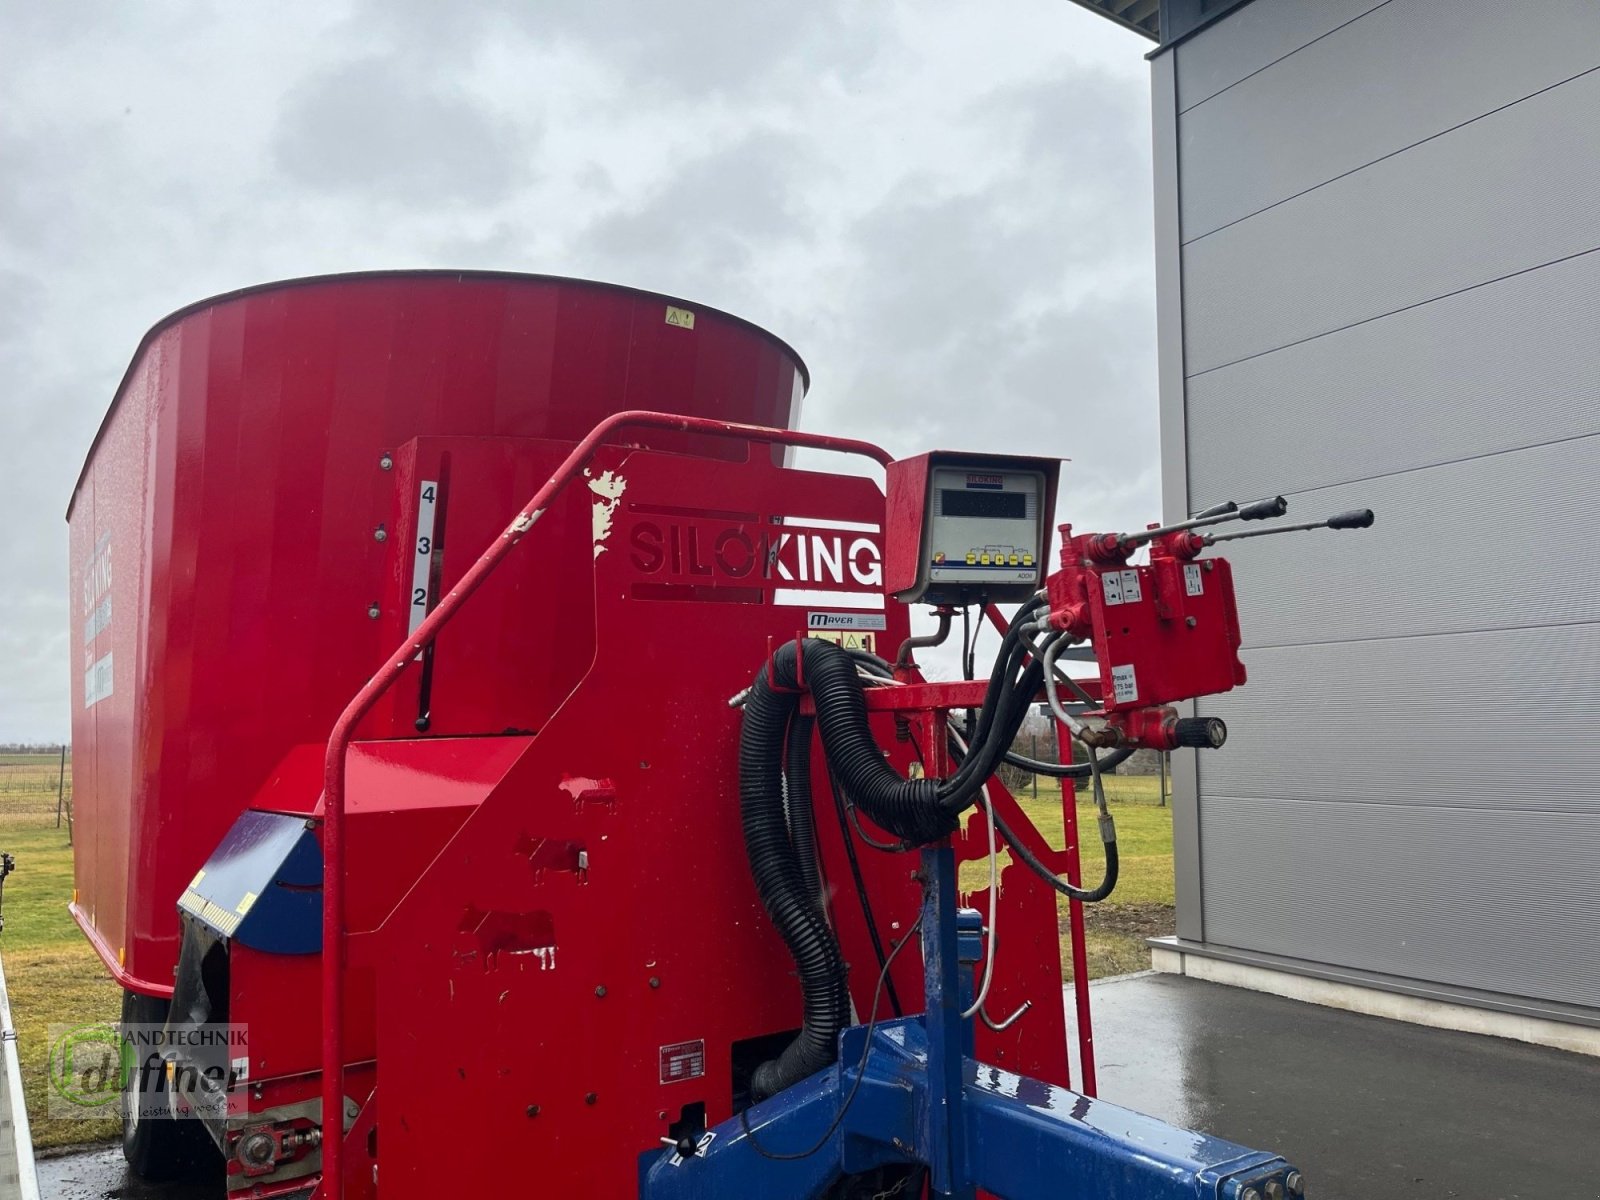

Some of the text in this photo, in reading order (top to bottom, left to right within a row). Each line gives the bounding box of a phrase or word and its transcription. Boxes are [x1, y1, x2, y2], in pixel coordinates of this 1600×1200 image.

[422, 486, 435, 504] 4
[418, 537, 430, 554] 3
[630, 521, 882, 586] SILOKING
[413, 588, 426, 606] 2
[811, 614, 853, 625] MAYER
